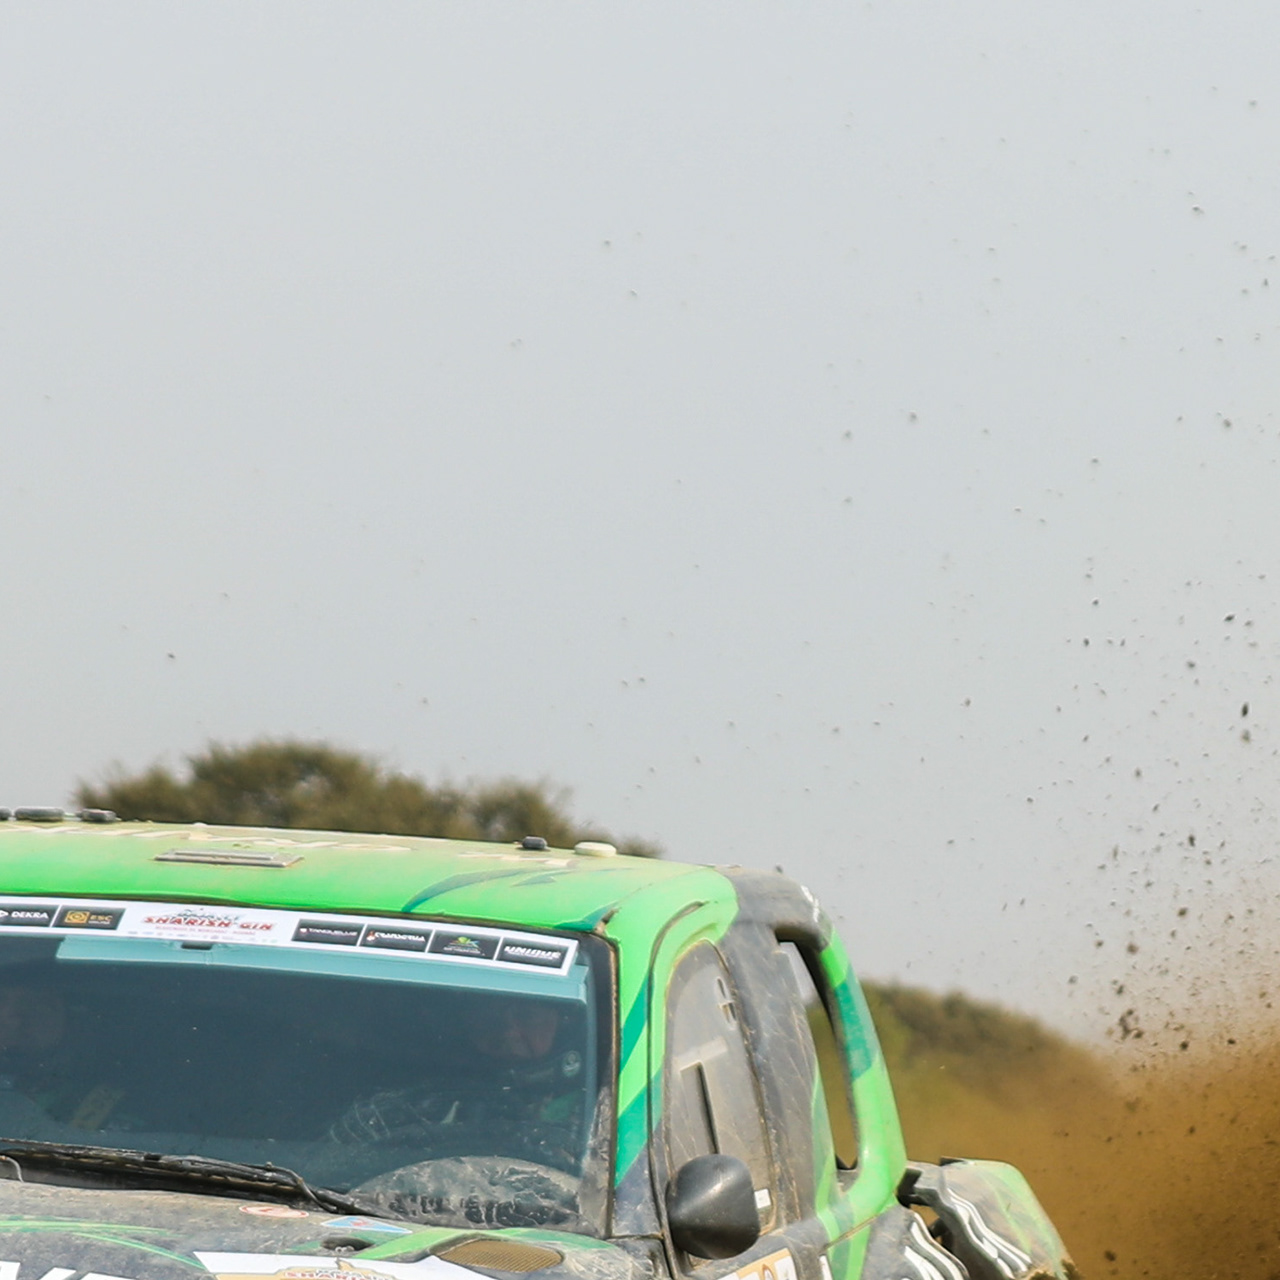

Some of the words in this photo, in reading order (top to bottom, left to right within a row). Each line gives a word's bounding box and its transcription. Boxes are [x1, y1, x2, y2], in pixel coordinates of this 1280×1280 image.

[11, 910, 49, 920] DEKRA
[90, 914, 113, 922] ESC
[143, 915, 232, 929] SHARISH
[238, 922, 275, 932] GIN
[504, 945, 562, 958] UNIQUE
